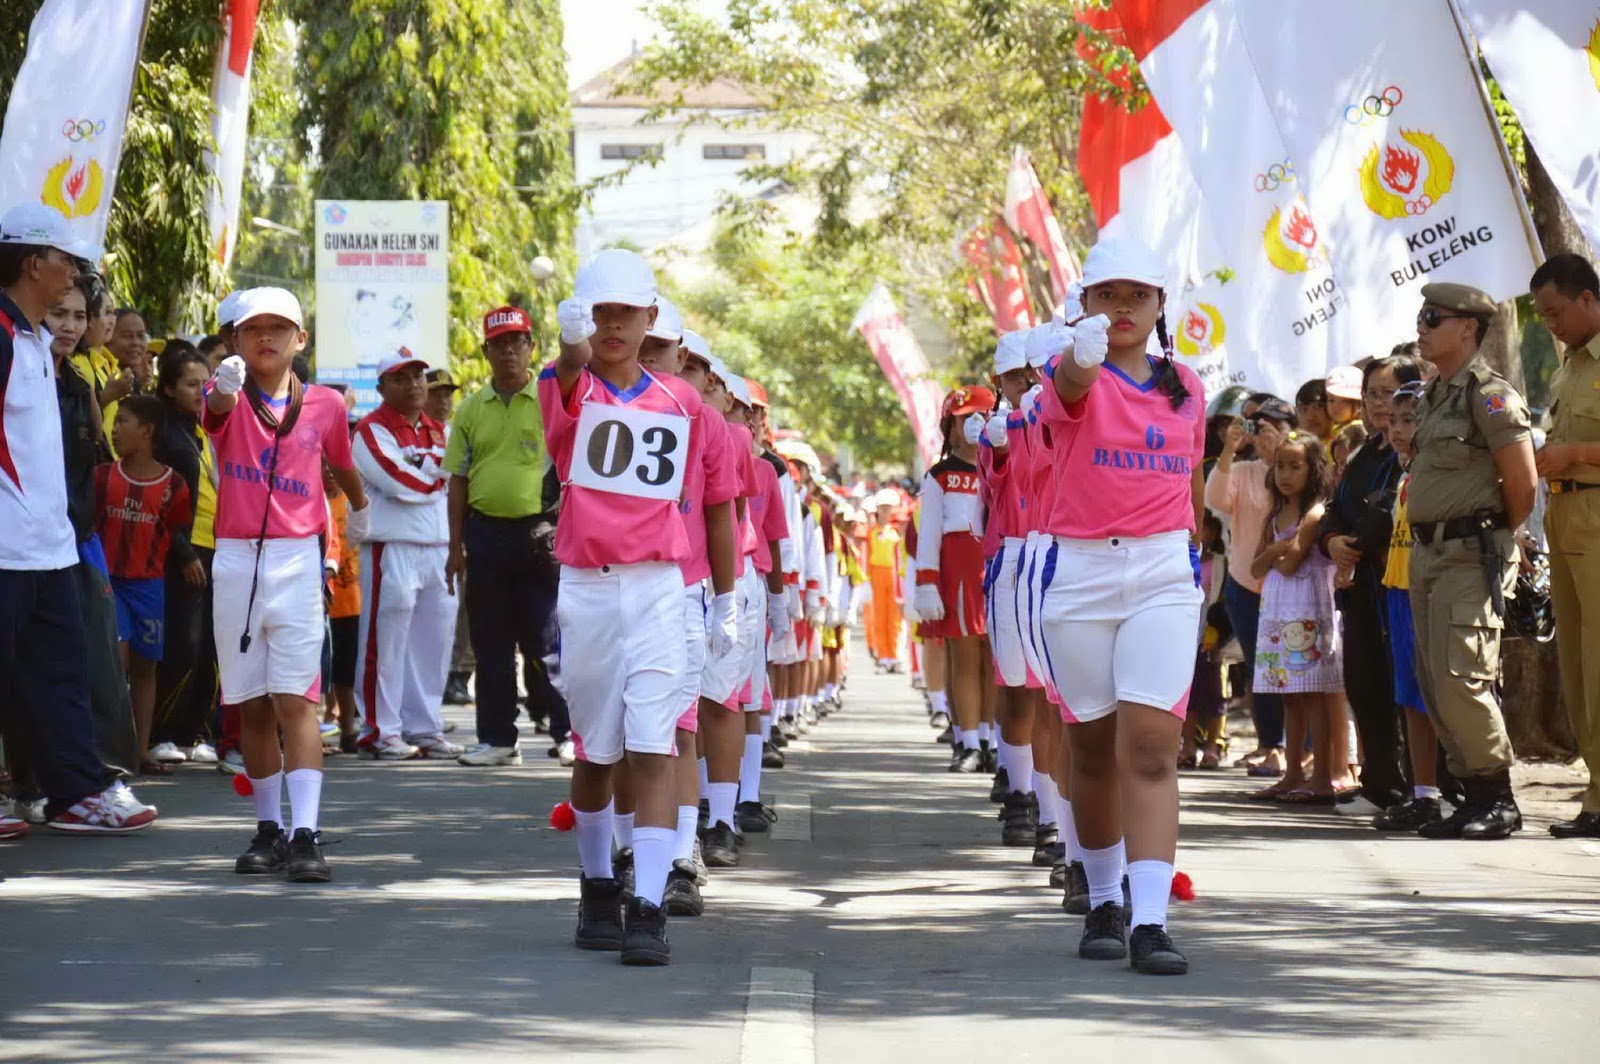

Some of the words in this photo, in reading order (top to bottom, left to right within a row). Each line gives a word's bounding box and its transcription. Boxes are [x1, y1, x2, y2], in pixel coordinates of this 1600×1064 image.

[324, 233, 378, 250] GUNAKAN
[382, 233, 417, 250] HELEM
[420, 234, 440, 250] SNI
[1406, 216, 1456, 252] KONI
[1390, 226, 1493, 287] BULELENG
[587, 419, 678, 486] 03
[1145, 425, 1166, 450] 6
[947, 474, 961, 489] SD
[962, 475, 971, 490] 3
